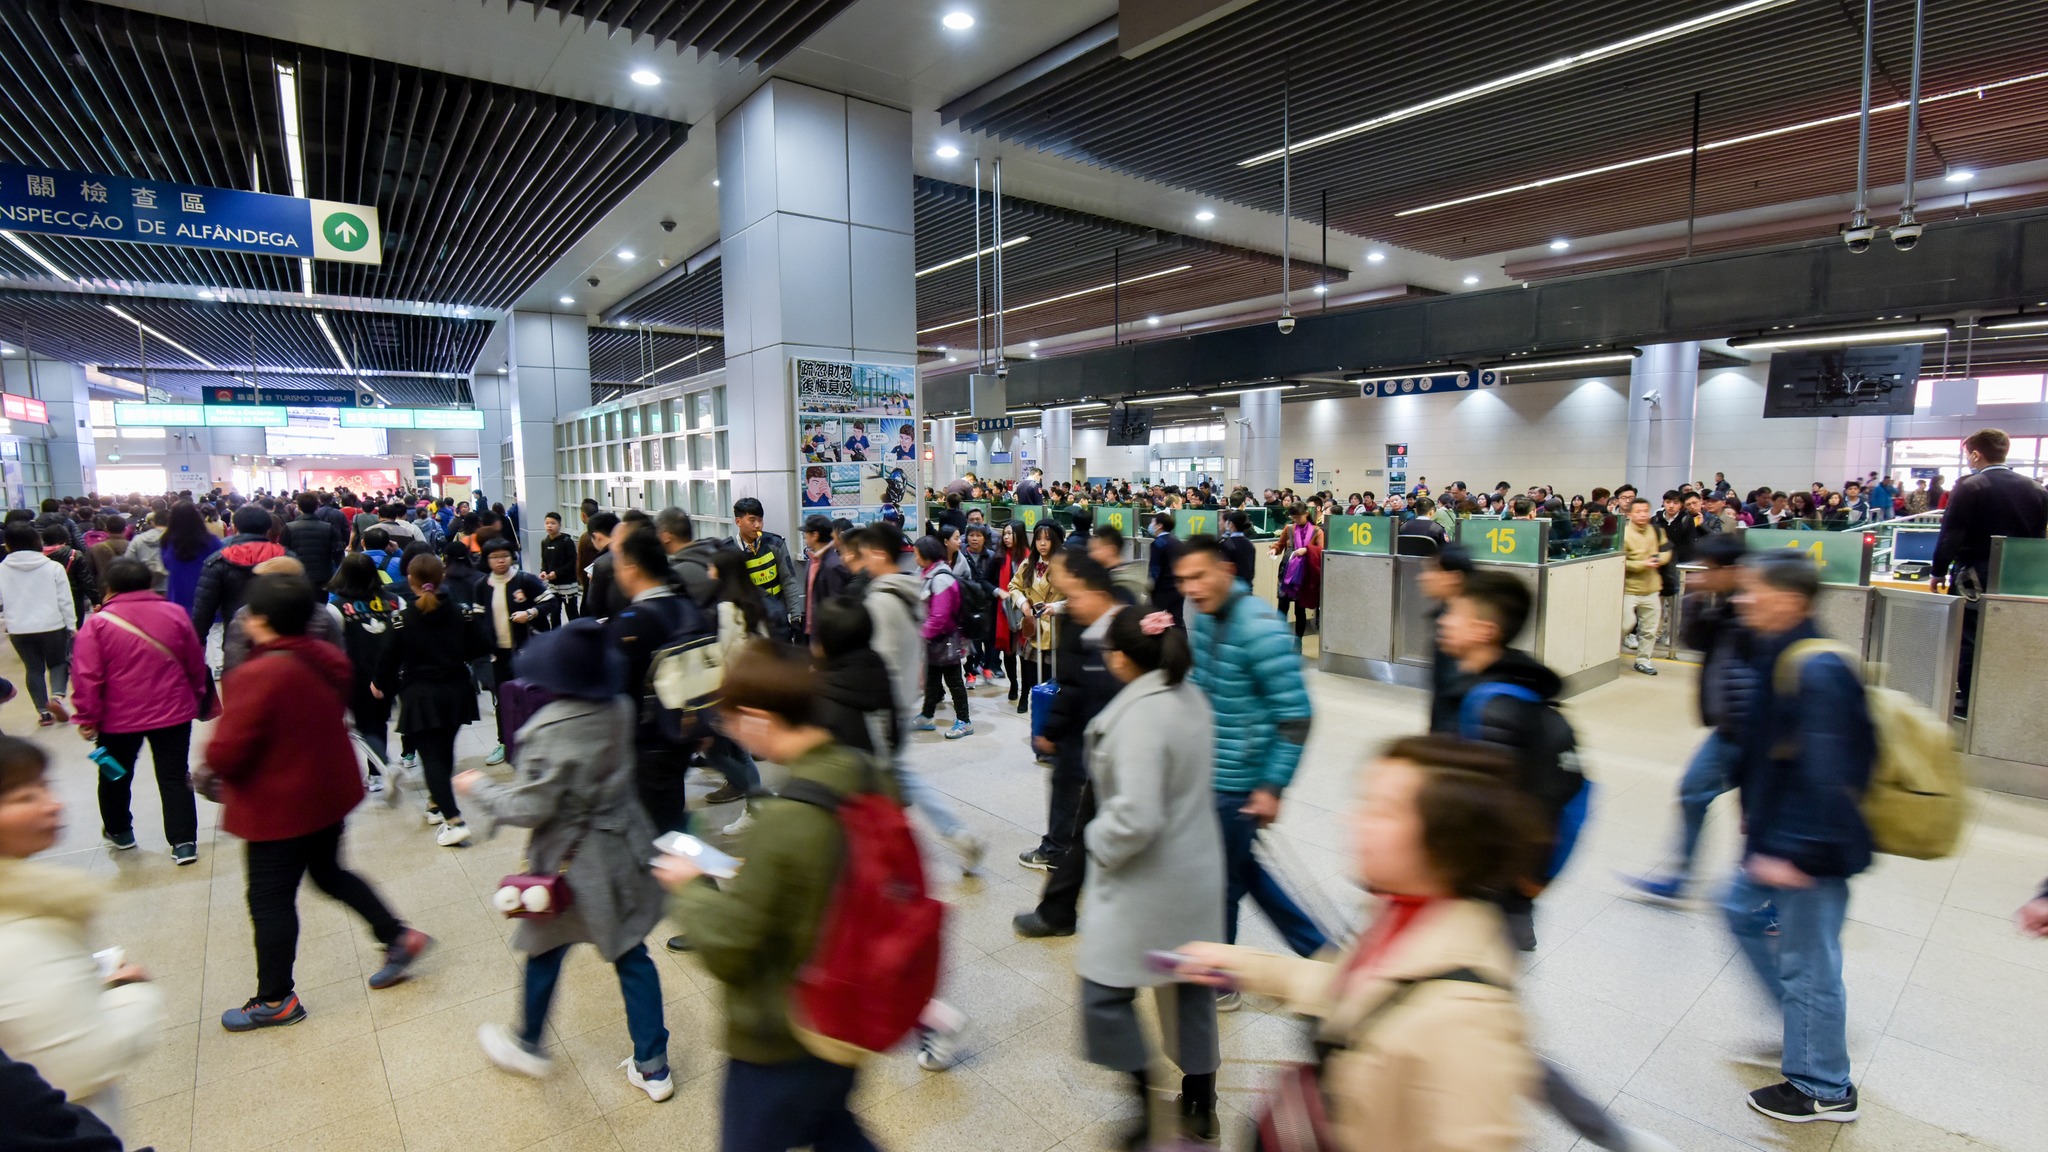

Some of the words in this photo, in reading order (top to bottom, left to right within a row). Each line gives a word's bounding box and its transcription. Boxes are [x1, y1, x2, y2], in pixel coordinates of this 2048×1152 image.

[0, 174, 206, 214] 關檢查區
[0, 205, 123, 231] NSPECÇÃO
[138, 219, 166, 236] DE
[176, 222, 299, 248] ALFÂNDEGA
[801, 361, 852, 379] 疏忽財物
[801, 378, 853, 395] 後悔莫及
[275, 394, 311, 402] TURISMO
[312, 395, 347, 403] TOURISM
[1023, 510, 1035, 526] 19
[1108, 513, 1123, 531] 18
[1188, 516, 1206, 535] 17
[1347, 522, 1372, 546] 16
[1486, 528, 1516, 554] 15
